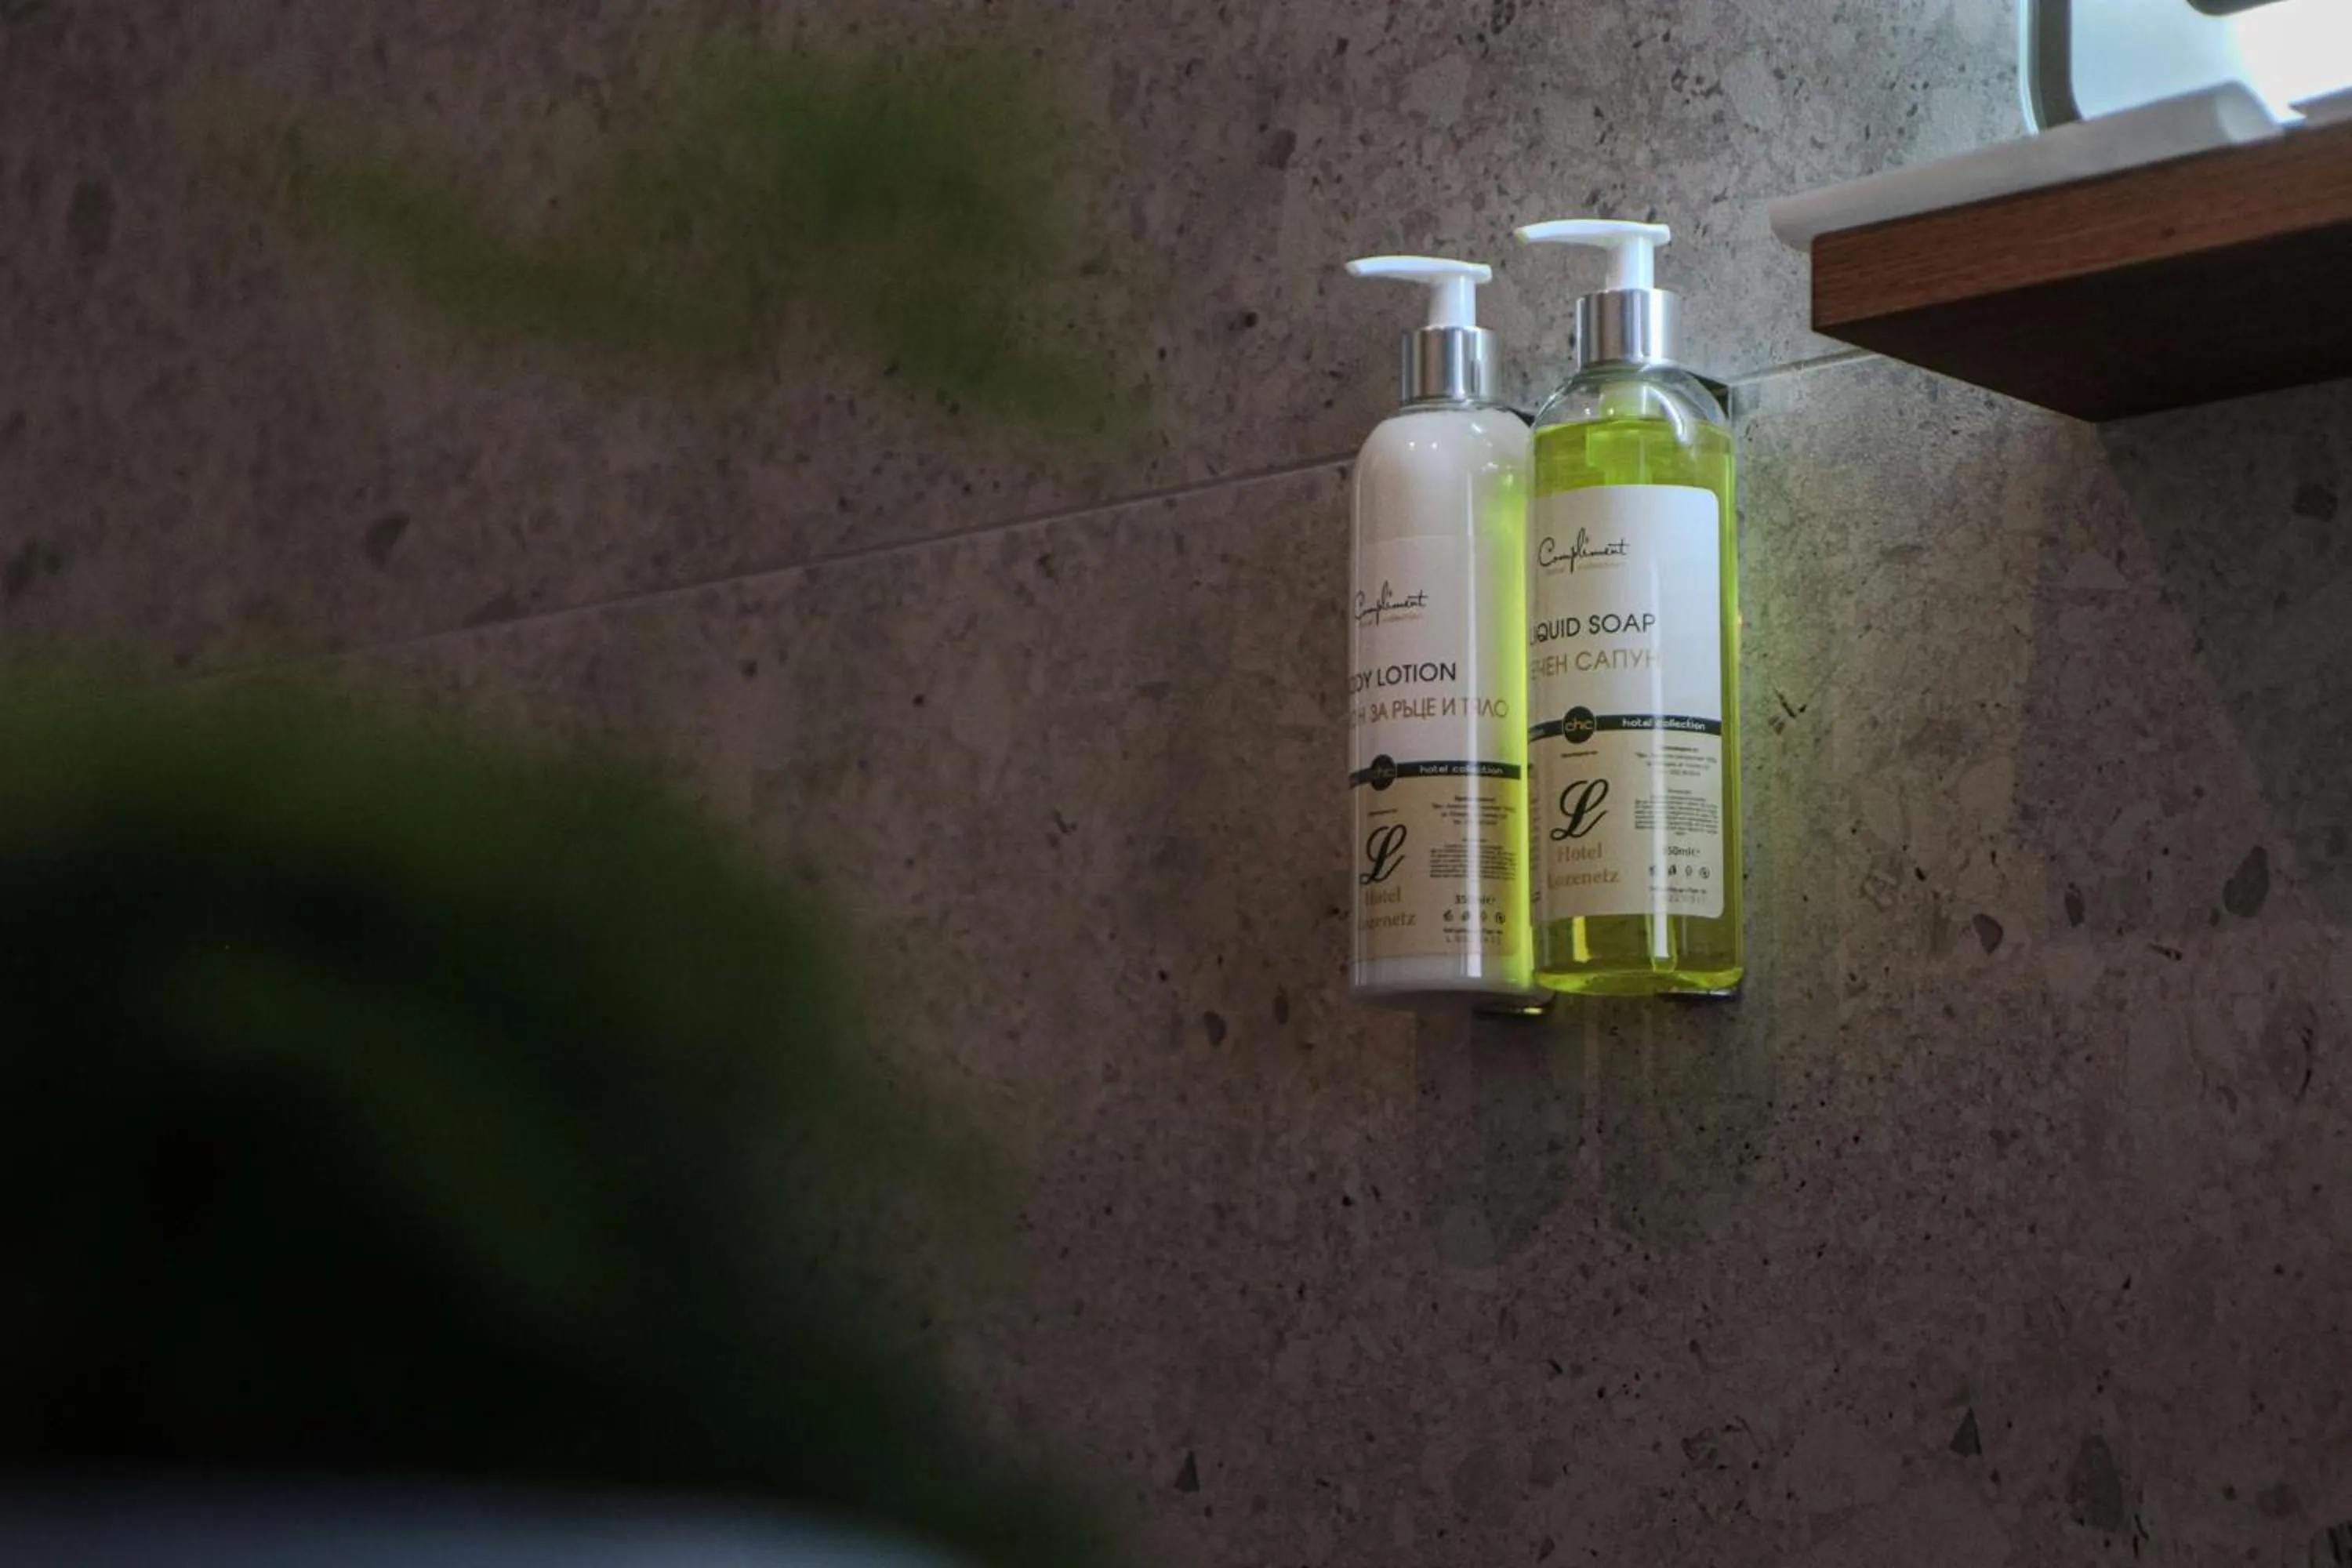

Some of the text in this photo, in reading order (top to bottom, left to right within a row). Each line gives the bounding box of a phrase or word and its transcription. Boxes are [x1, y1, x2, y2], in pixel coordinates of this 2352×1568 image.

[1539, 527, 1631, 574] Compliment
[1354, 580, 1428, 626] Compliment
[1530, 613, 1656, 646] IQUID SOAP
[1575, 648, 1660, 672] САПУН
[1377, 662, 1456, 687] LOTION
[1370, 702, 1388, 723] ЗА
[1392, 697, 1437, 720] РЪЦЕ
[1443, 697, 1456, 717] И
[1622, 717, 1652, 728] hotel
[1419, 764, 1448, 775] hotel
[1556, 843, 1602, 863] Hotel
